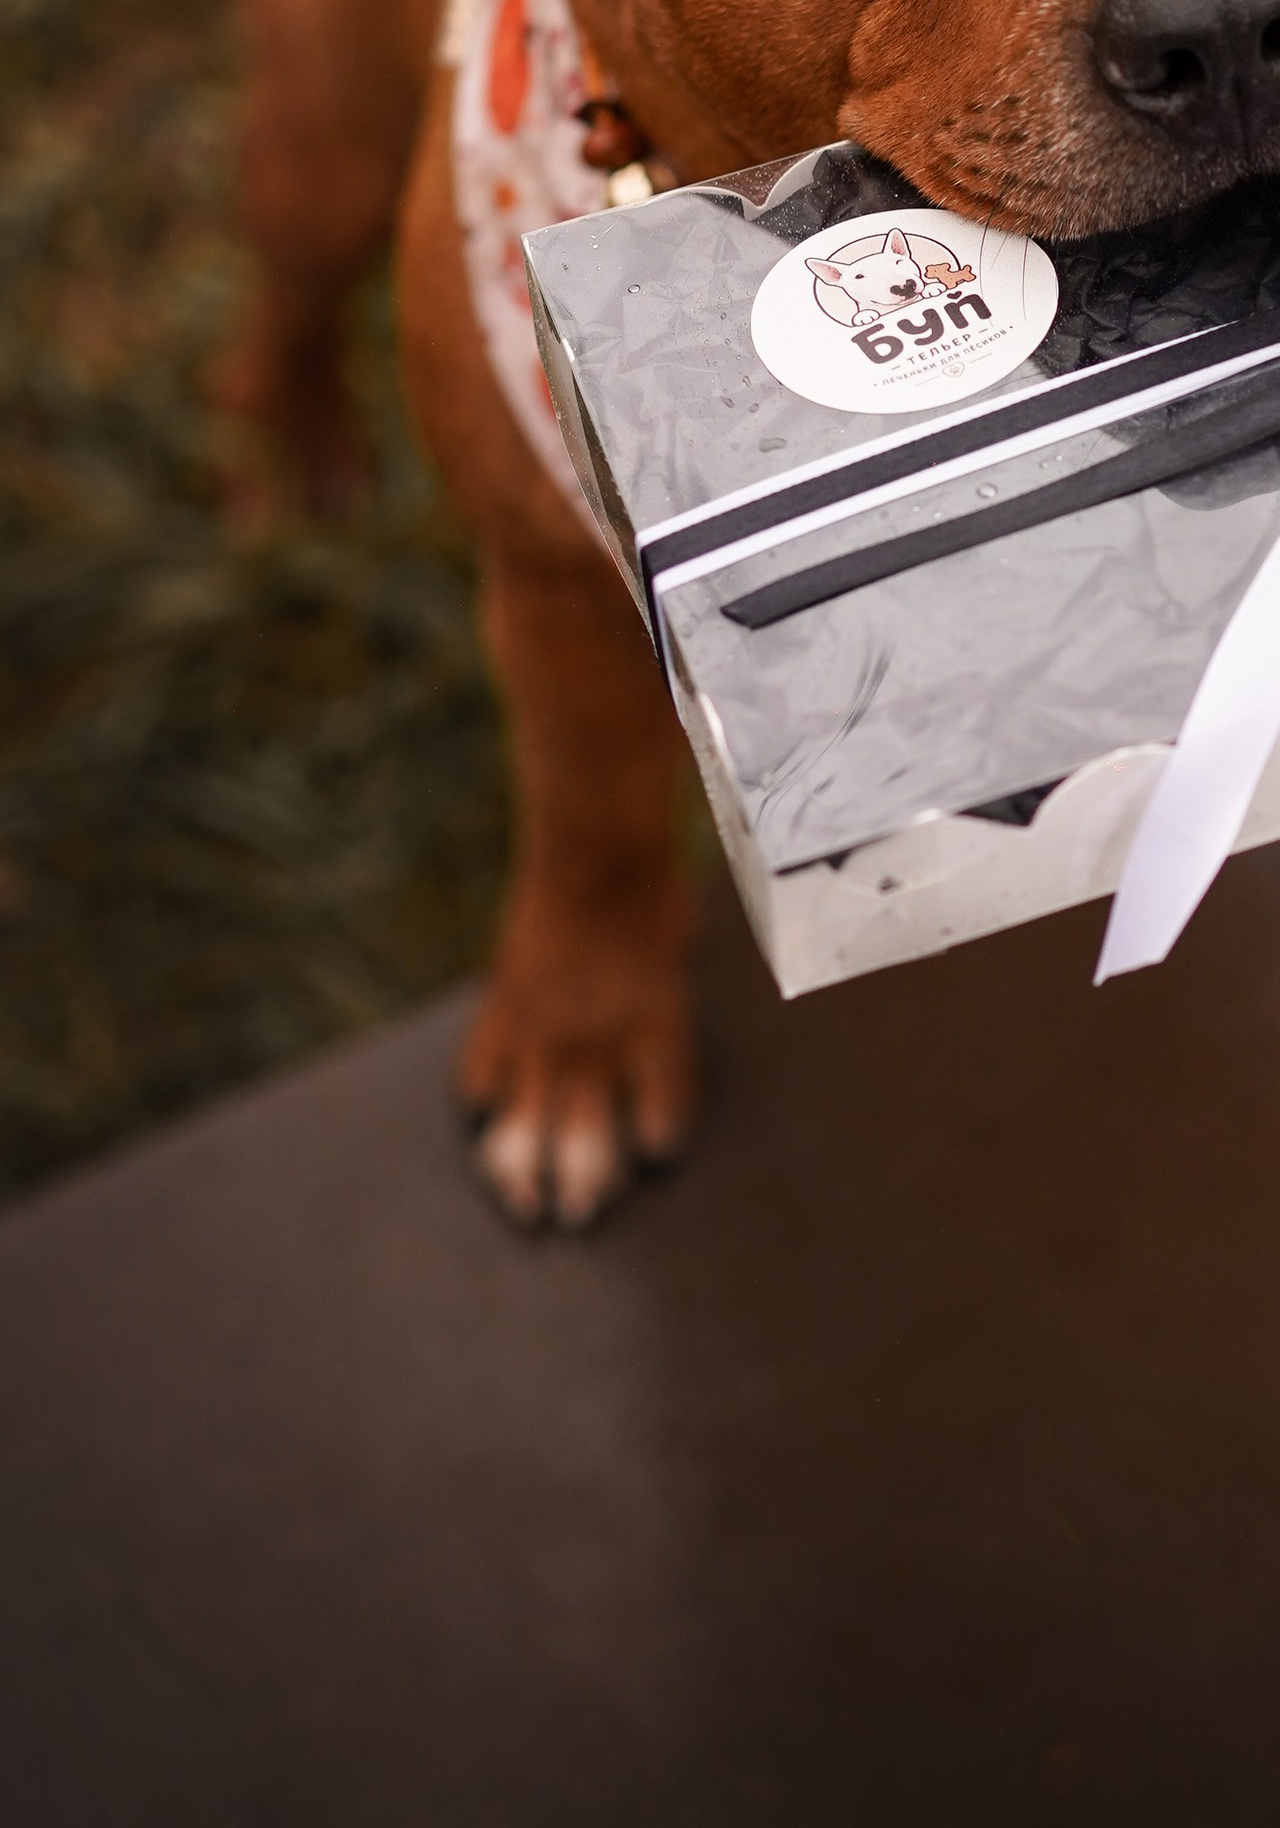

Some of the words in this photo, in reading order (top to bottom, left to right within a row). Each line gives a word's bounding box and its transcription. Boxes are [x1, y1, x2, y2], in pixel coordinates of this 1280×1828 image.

[906, 333, 971, 365] ТЕЛЬЕР
[881, 362, 937, 385] ПЕЧЕНЬКИ
[941, 353, 961, 366] ДЛЯ
